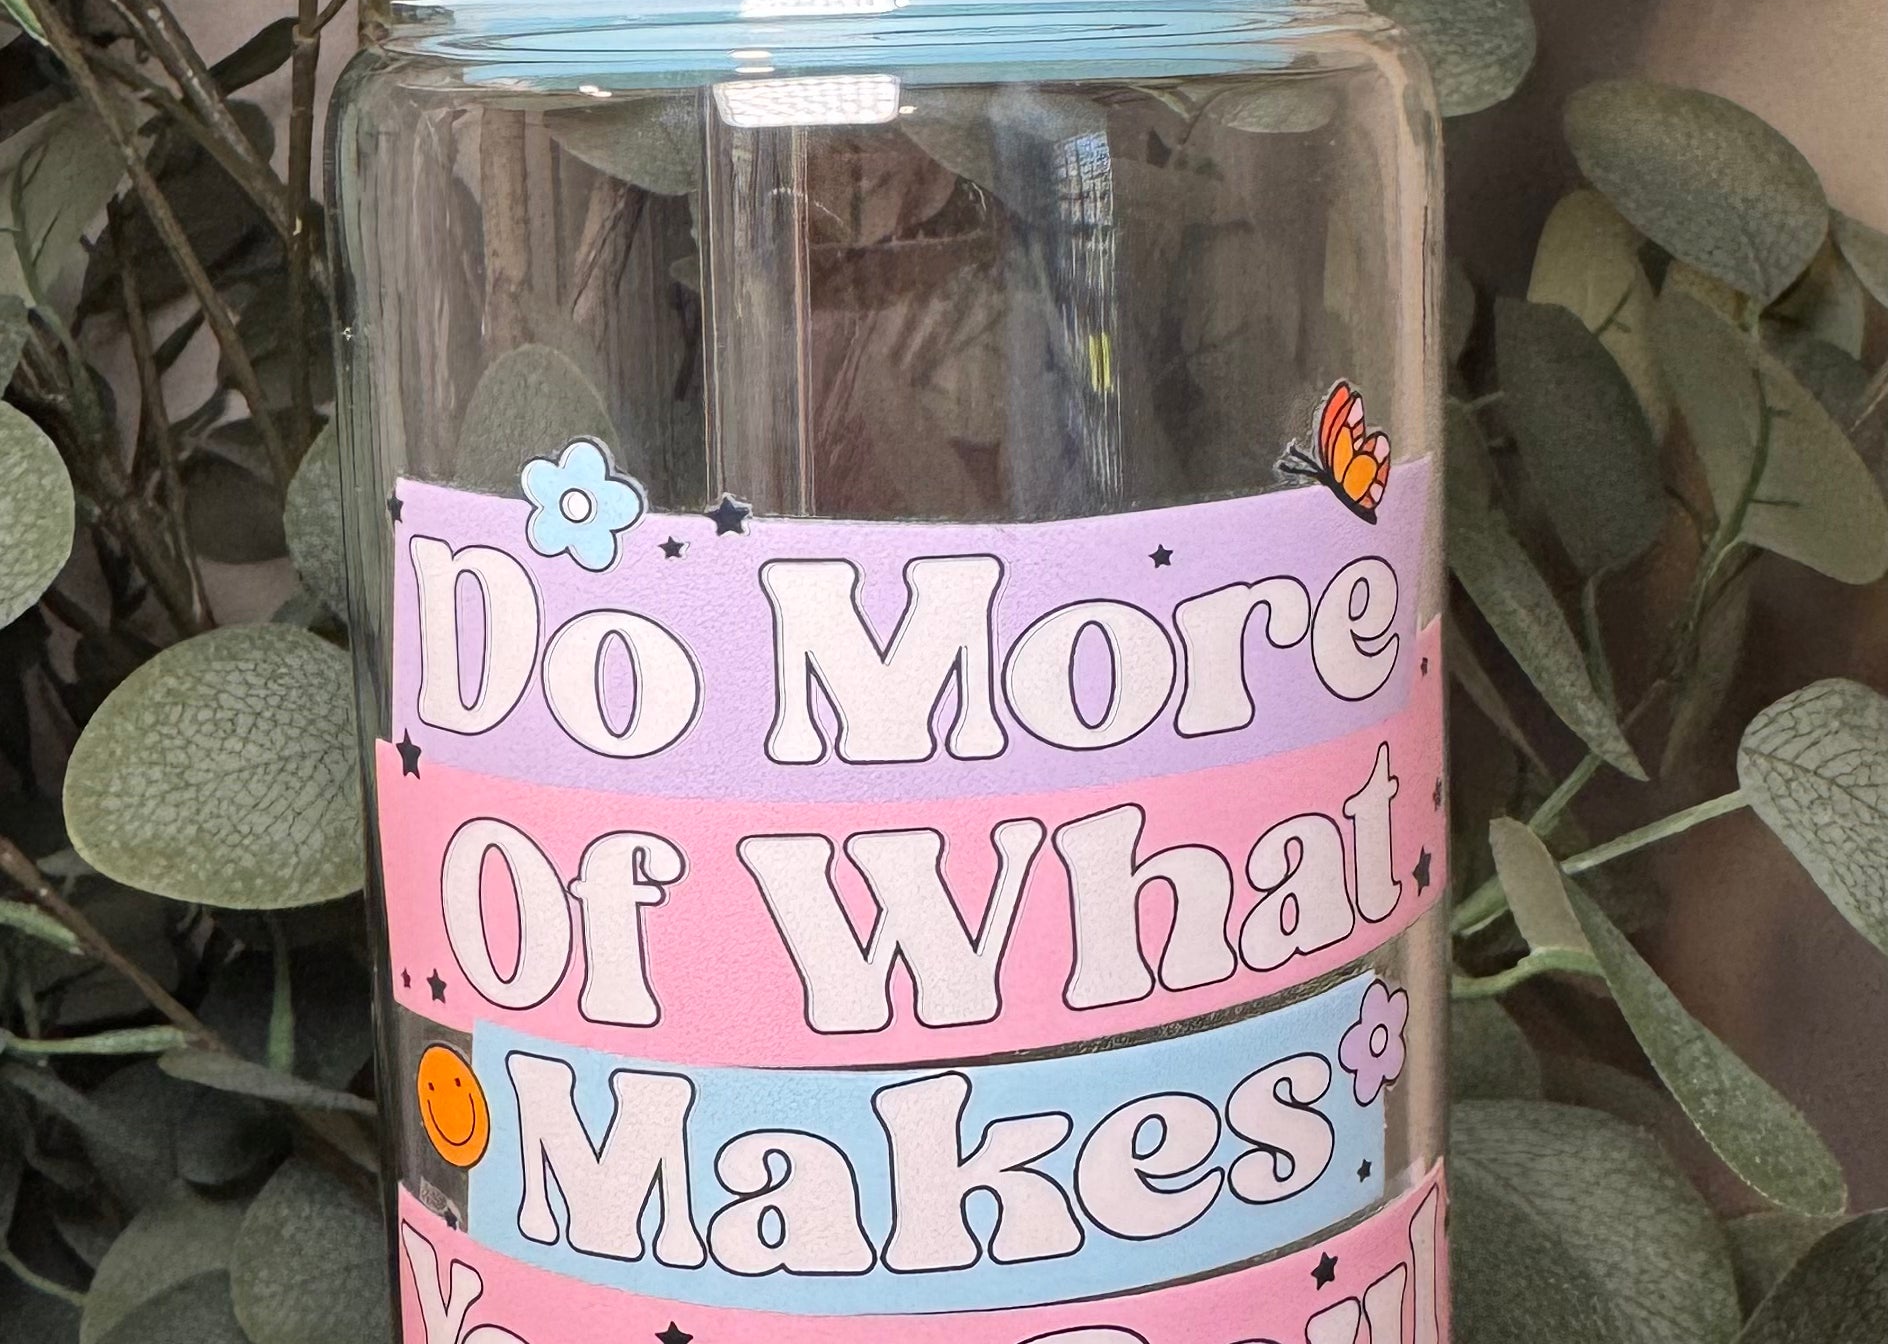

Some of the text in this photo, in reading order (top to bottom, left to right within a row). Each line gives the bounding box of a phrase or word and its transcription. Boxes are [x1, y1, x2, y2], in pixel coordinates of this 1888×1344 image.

[408, 534, 1400, 766] Do More
[441, 742, 1402, 1034] Of What
[505, 1051, 1337, 1277] Makes
